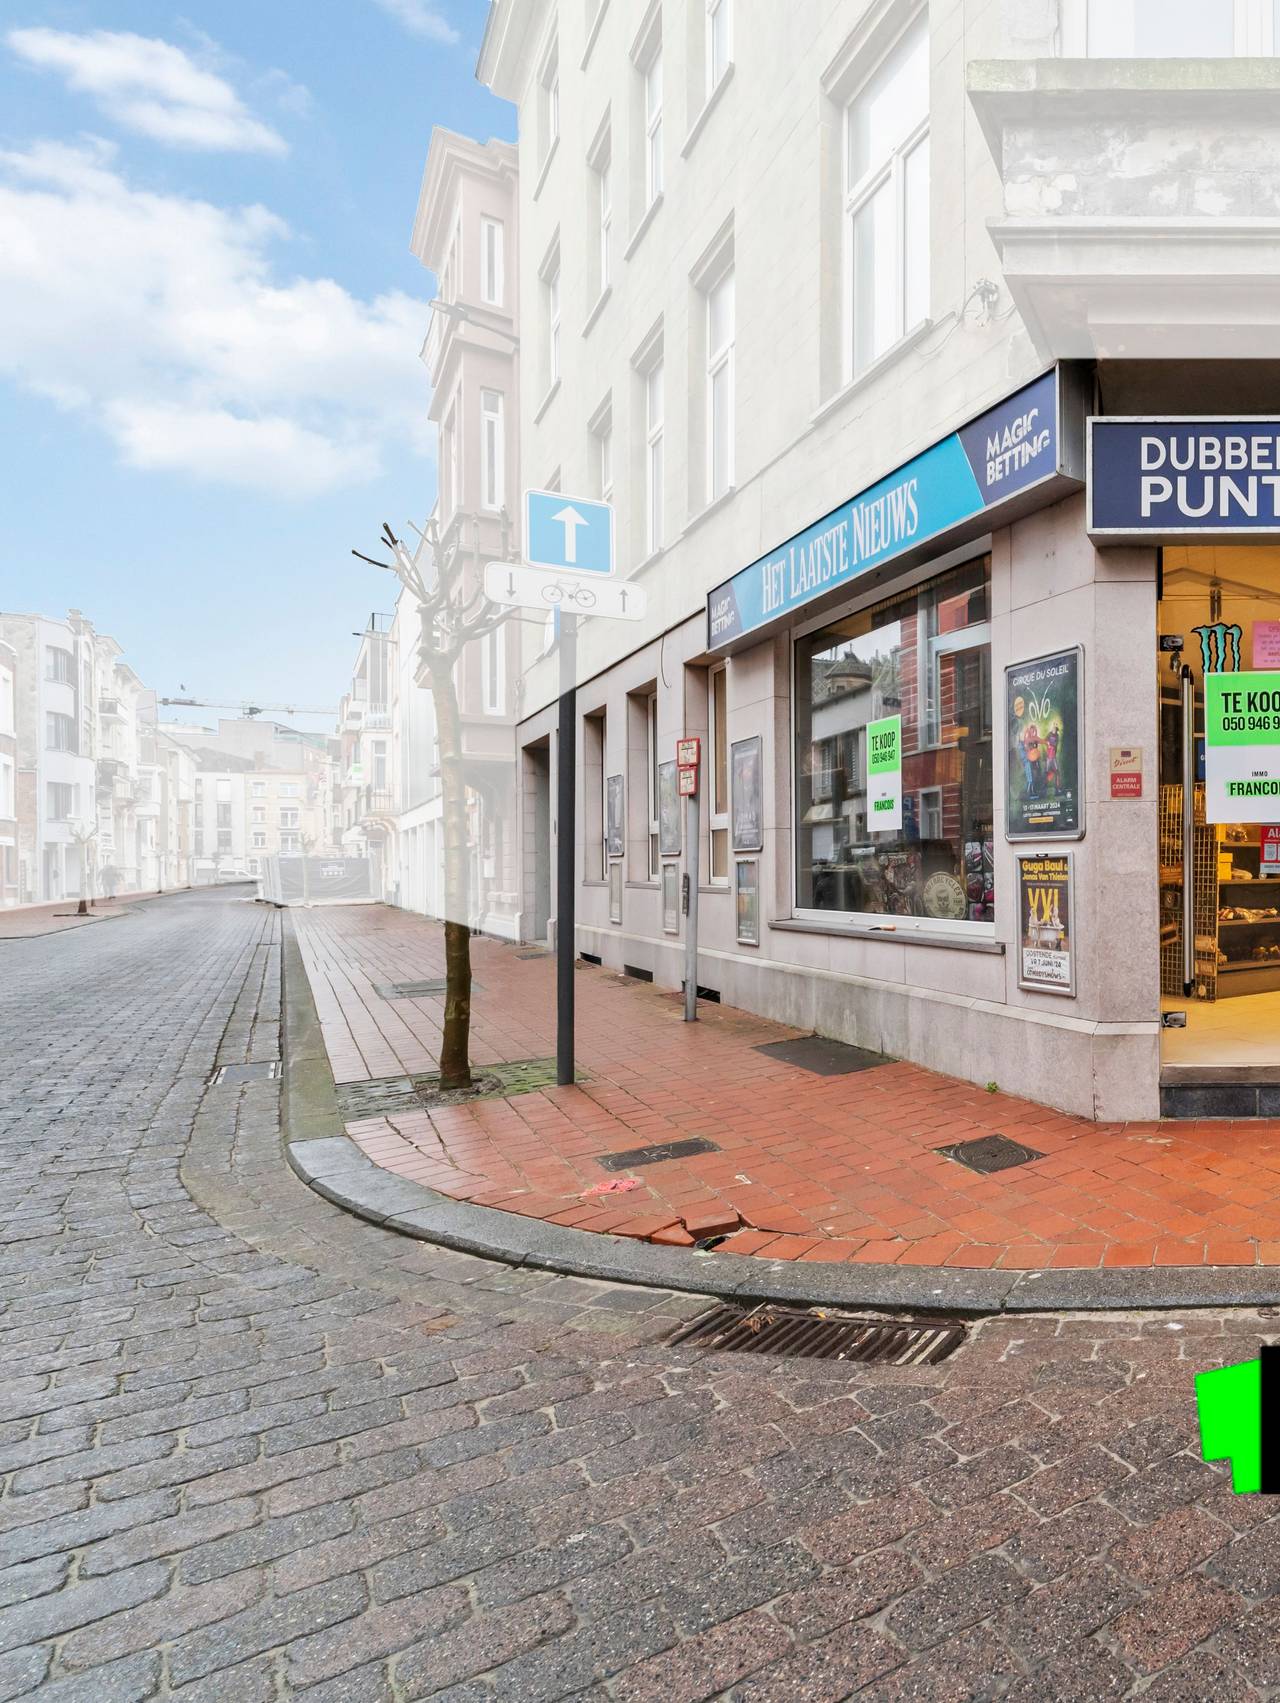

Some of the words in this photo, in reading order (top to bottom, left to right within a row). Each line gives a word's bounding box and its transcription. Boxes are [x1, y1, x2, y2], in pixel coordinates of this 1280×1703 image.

[986, 408, 1038, 460] MAGIC
[986, 429, 1050, 486] BETTING
[762, 562, 786, 614] HET
[789, 519, 849, 599] LAATSTE
[852, 479, 918, 562] NIEUWS
[711, 596, 730, 620] MAGIC
[711, 610, 735, 637] BETTING
[1036, 670, 1046, 680] DU
[1046, 664, 1069, 678] SOLEIL
[1221, 692, 1242, 714] TE
[1222, 716, 1246, 731] 050
[1248, 716, 1271, 730] 946
[871, 734, 878, 751] TE
[879, 731, 896, 749] KOOP
[874, 799, 895, 812] FRANCOIS
[1022, 860, 1043, 873] Guga
[1025, 950, 1052, 959] OOSTENDE
